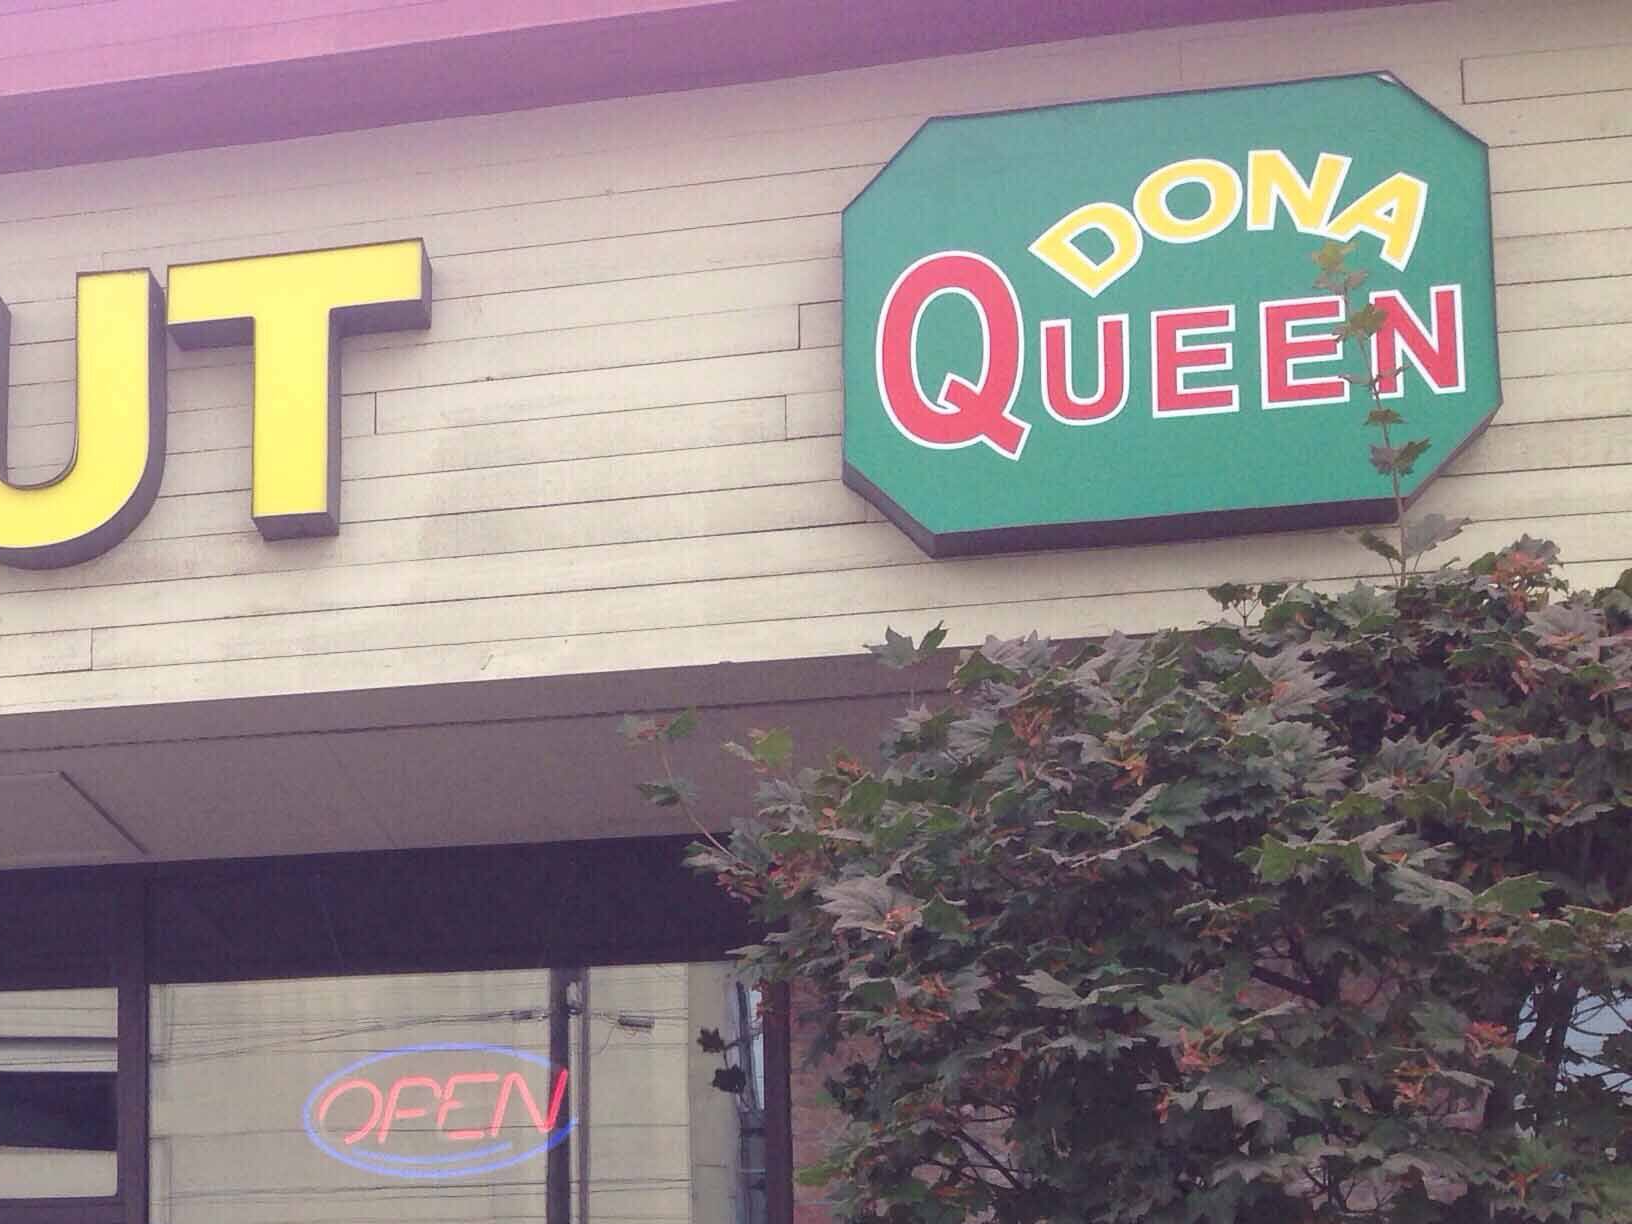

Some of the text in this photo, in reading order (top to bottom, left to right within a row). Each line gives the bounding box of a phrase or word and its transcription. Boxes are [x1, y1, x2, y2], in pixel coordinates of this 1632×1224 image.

[1028, 149, 1428, 296] DONA
[875, 249, 1465, 461] QUEEN
[317, 1068, 568, 1145] OPEN
